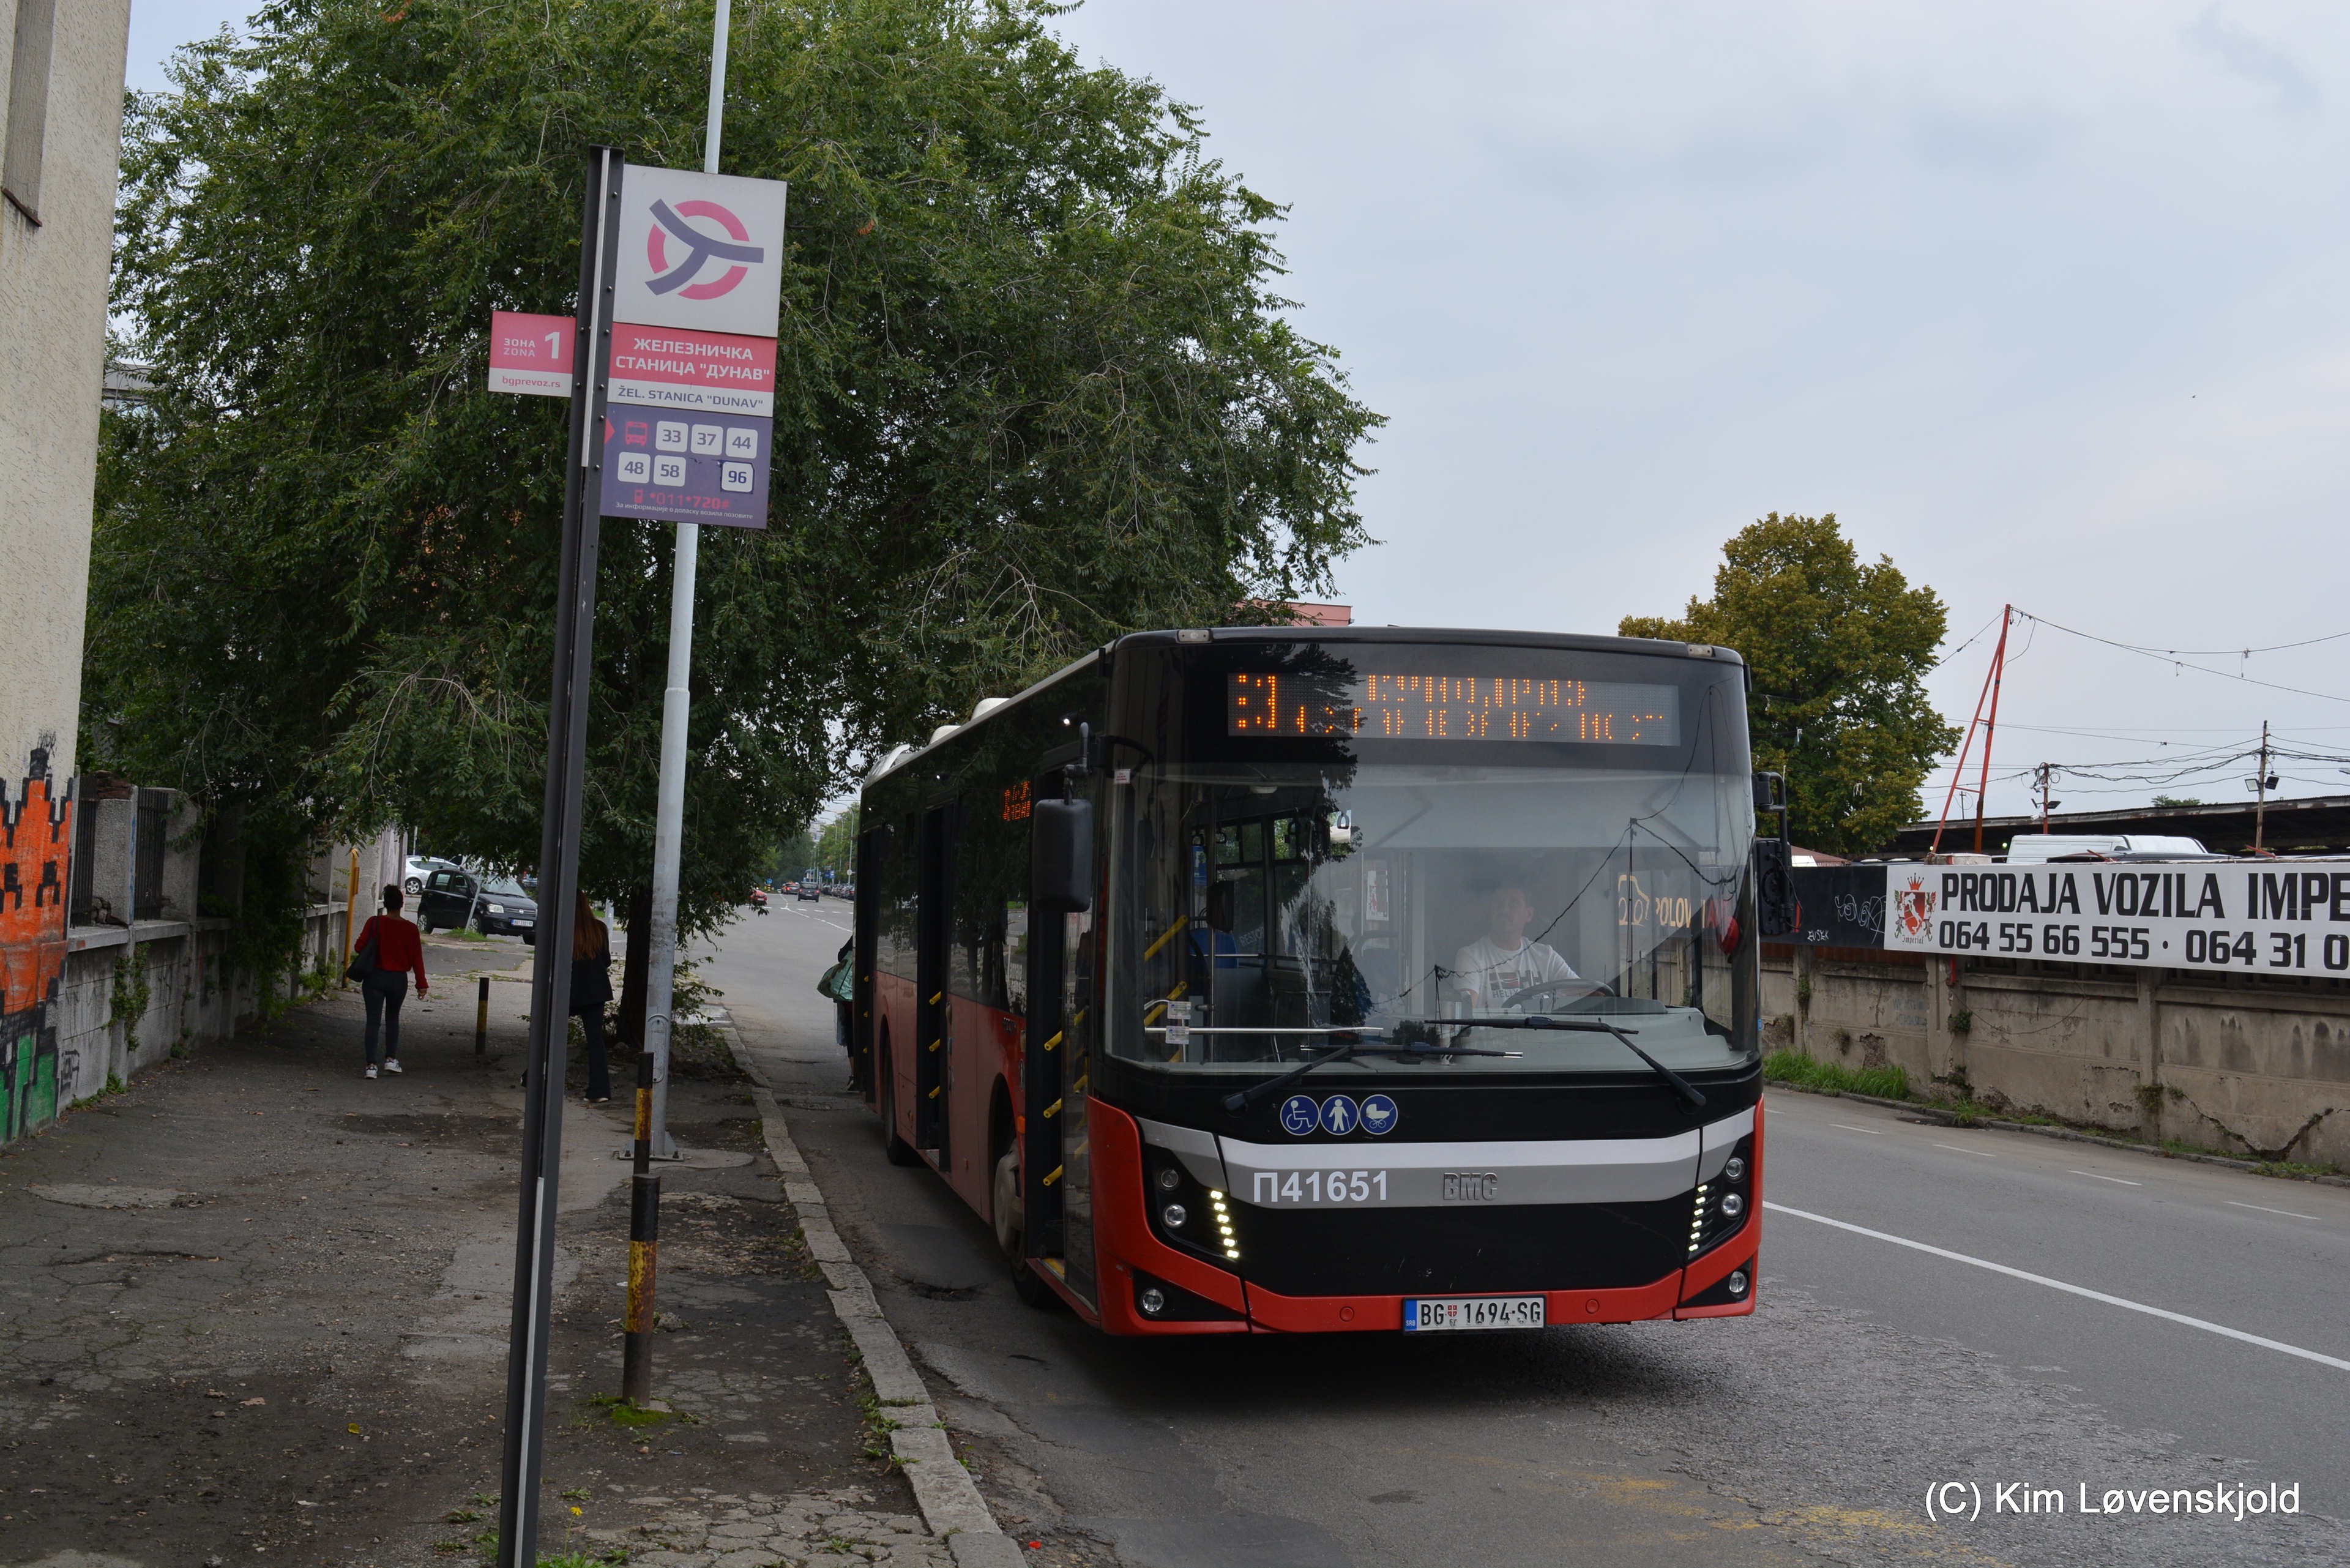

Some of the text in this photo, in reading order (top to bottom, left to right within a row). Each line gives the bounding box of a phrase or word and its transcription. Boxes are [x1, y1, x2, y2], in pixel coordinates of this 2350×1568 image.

[504, 338, 535, 348] ЗОНА
[504, 347, 535, 357] ZONA
[545, 331, 560, 359] 1
[633, 338, 753, 360] ЖЕЛЕЗНИЧКА
[616, 356, 770, 381] СТАНИЦА "ДУНАВ"
[502, 376, 561, 387] bgprevoz.rs
[617, 384, 763, 408] ŽEL. STANICA "DUNAV"
[662, 429, 752, 450] 33 37 44
[624, 461, 747, 483] 48 58 96
[625, 503, 668, 513] информације
[1941, 872, 2350, 922] PRODAJA VOZILA IMPE
[1939, 920, 2349, 971] 064 55 66 555 064 31 0
[1253, 1170, 1387, 1203] П41651
[1443, 1172, 1498, 1200] BMC
[1420, 1303, 1445, 1326] BG
